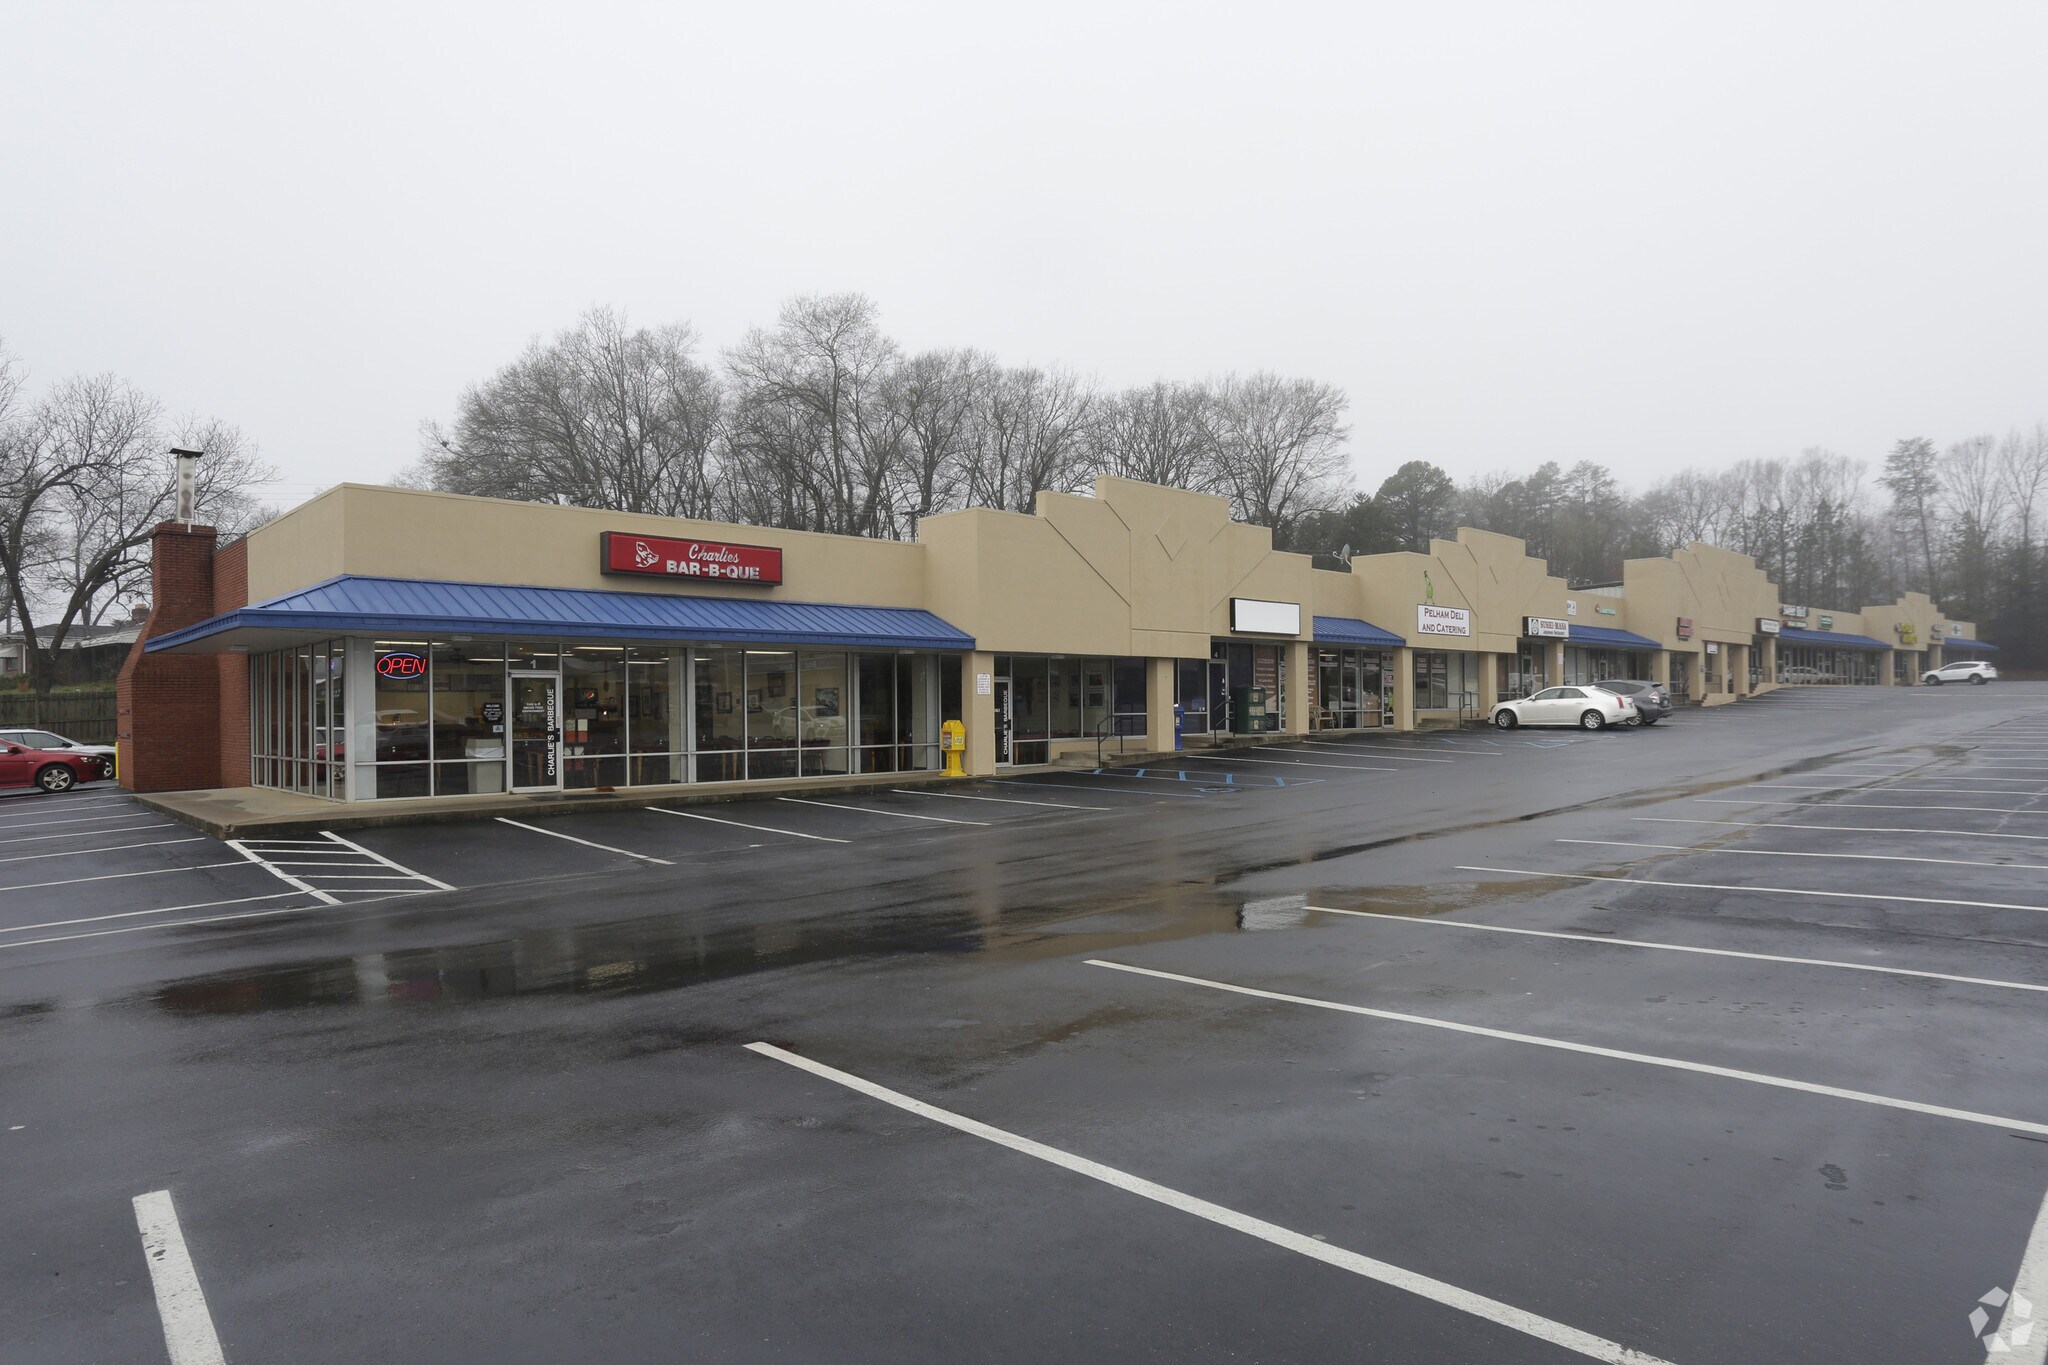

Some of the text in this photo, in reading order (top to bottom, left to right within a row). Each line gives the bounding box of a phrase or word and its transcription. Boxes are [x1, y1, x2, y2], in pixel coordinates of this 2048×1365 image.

[688, 543, 740, 563] Charlies
[666, 560, 760, 580] BAR-B-QUE
[376, 657, 427, 674] OPEN
[530, 659, 537, 669] 1
[547, 734, 555, 776] CHARLIE'S
